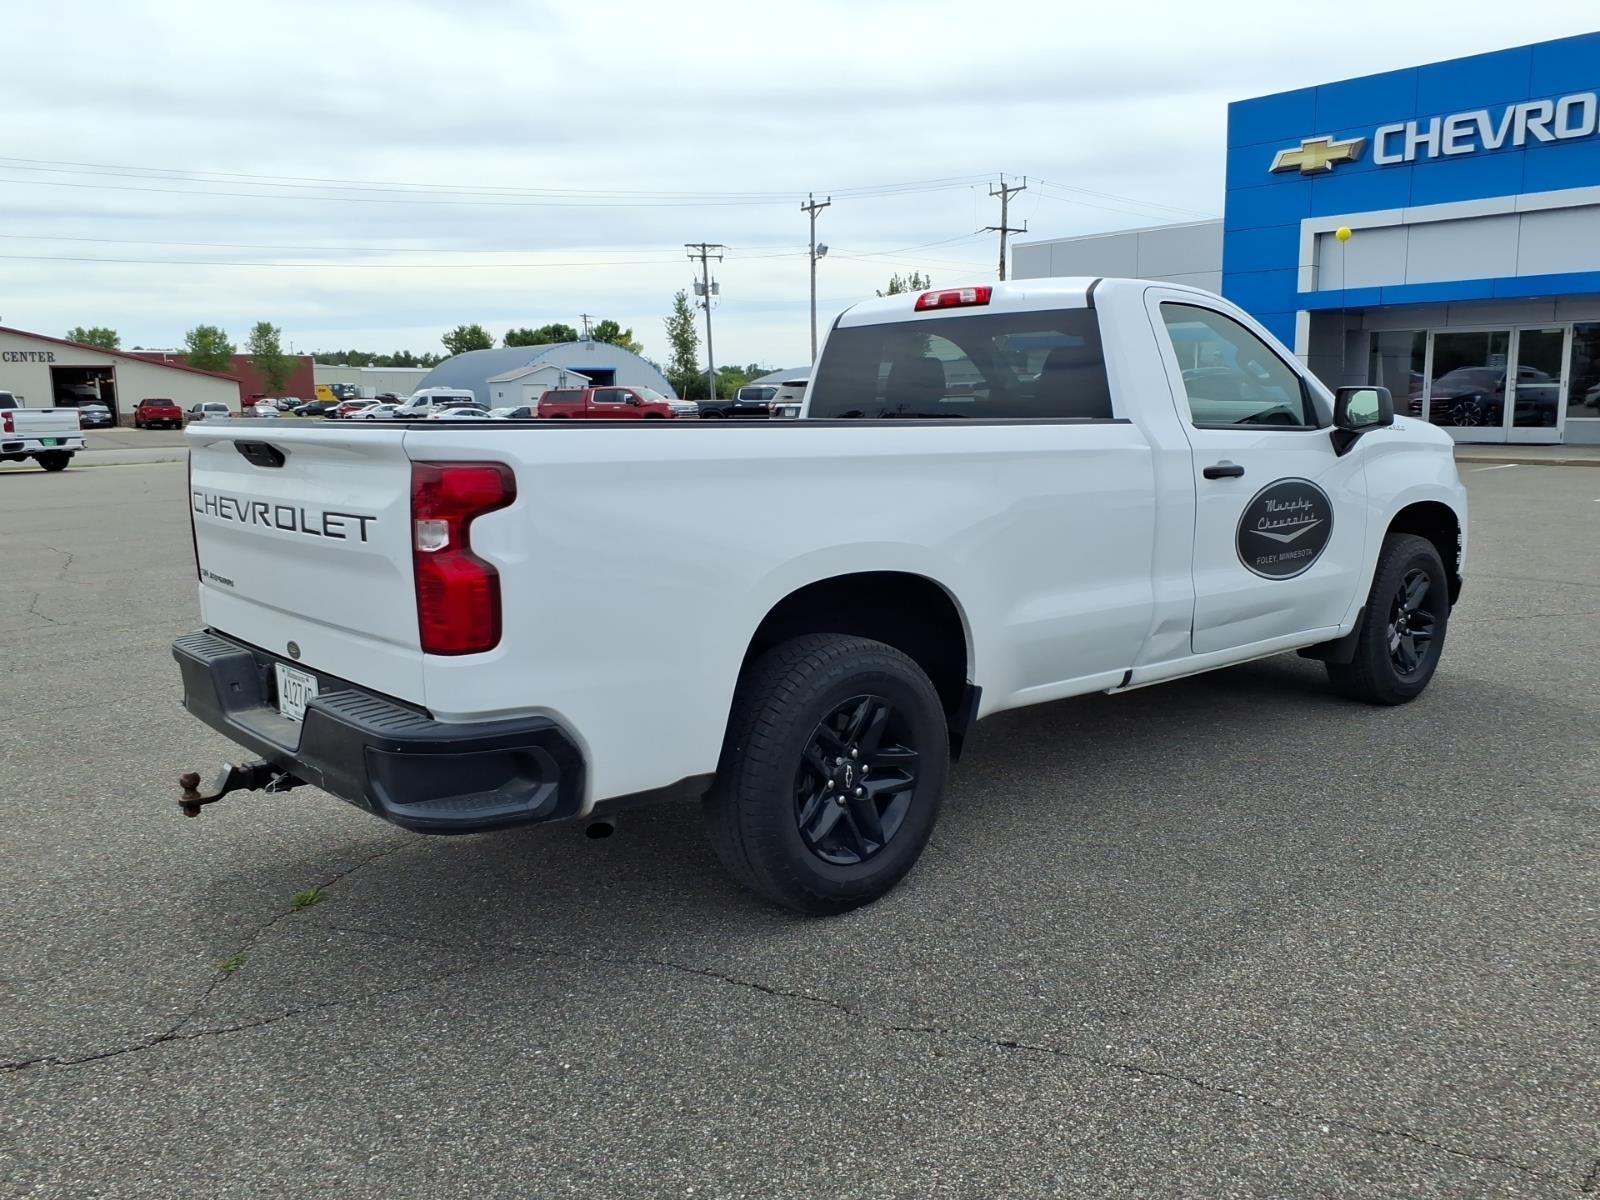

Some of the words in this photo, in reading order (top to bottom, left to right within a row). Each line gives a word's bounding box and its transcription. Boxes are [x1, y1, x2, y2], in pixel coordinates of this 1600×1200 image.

[1373, 92, 1600, 165] CHEVRO
[2, 351, 56, 363] CENTER
[1265, 497, 1313, 513] Murphy
[193, 491, 377, 542] CHEVROLET
[1257, 513, 1318, 529] Chevrolet
[1279, 548, 1313, 561] MINNESOTA
